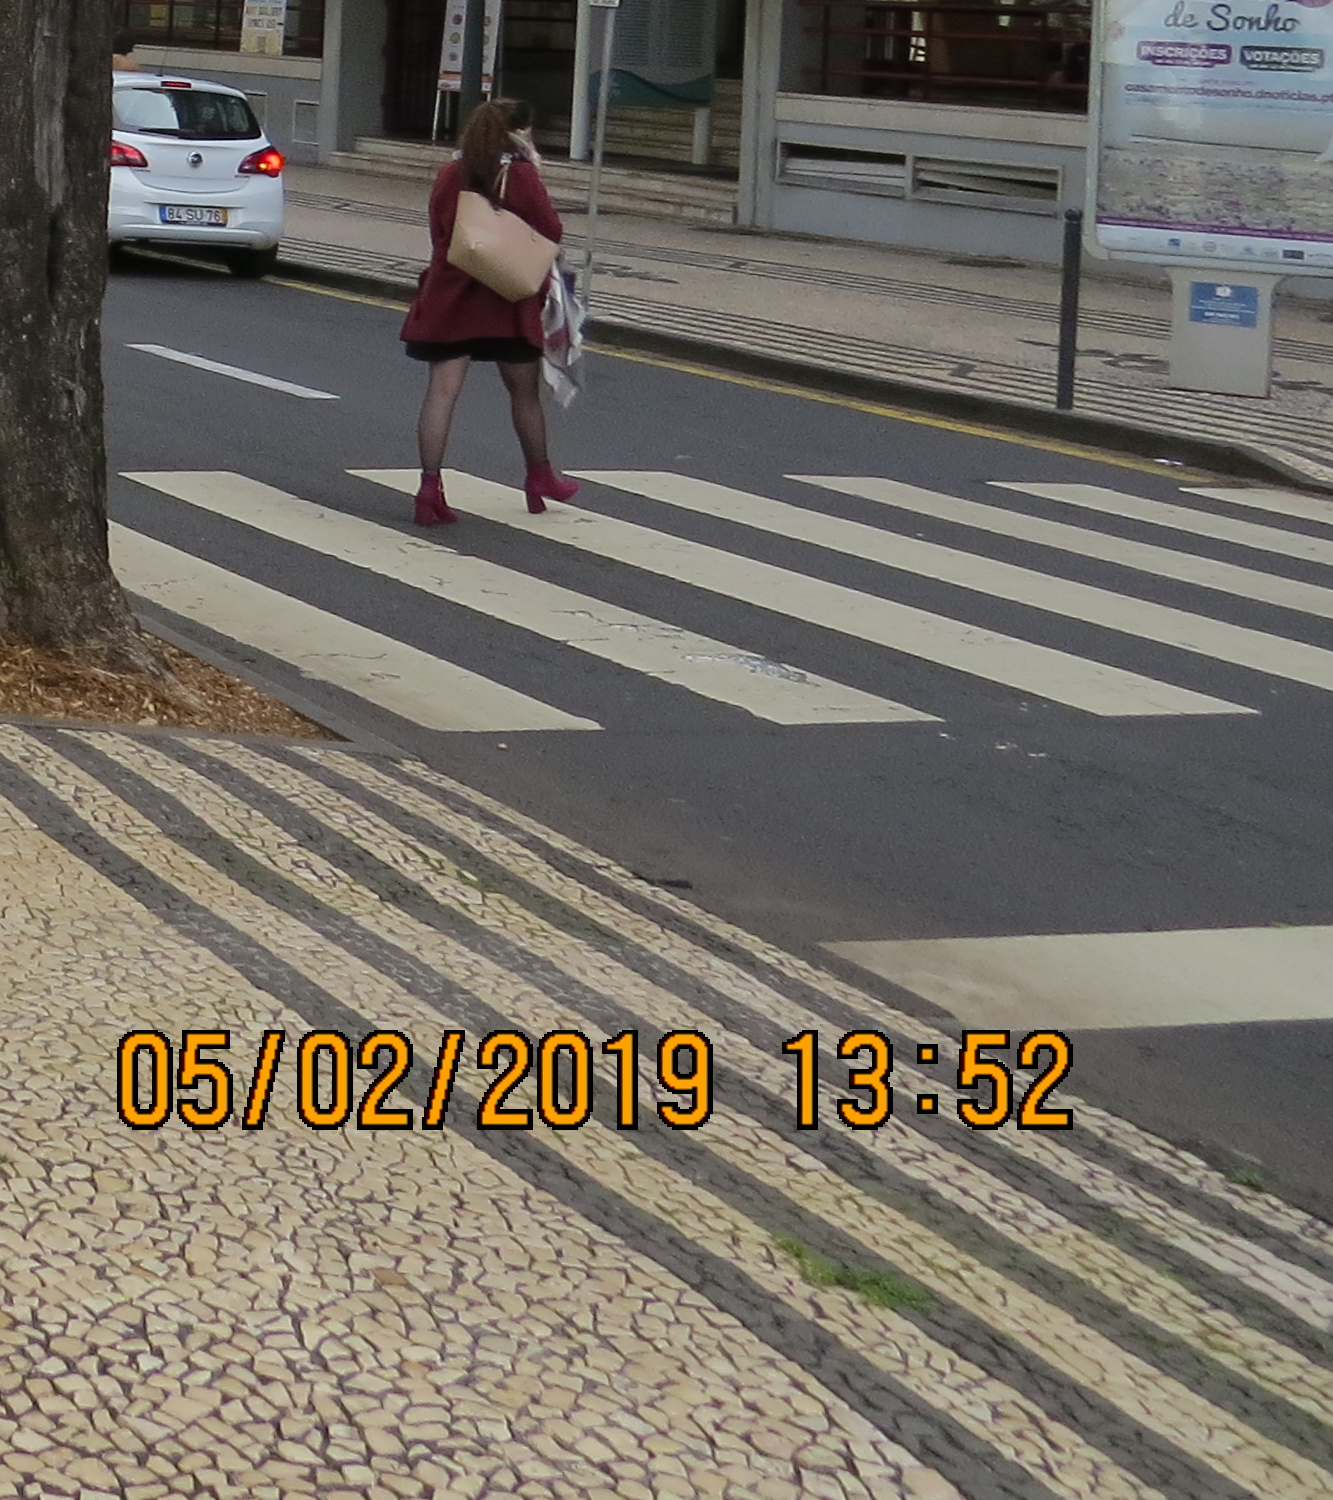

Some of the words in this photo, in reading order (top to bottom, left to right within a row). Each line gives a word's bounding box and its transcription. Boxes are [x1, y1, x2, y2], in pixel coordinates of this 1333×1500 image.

[1164, 0, 1199, 28] de
[1206, 3, 1301, 32] Sonho
[1140, 45, 1227, 61] INSCRIÇÕES
[1244, 49, 1321, 65] VOTAÇÕES
